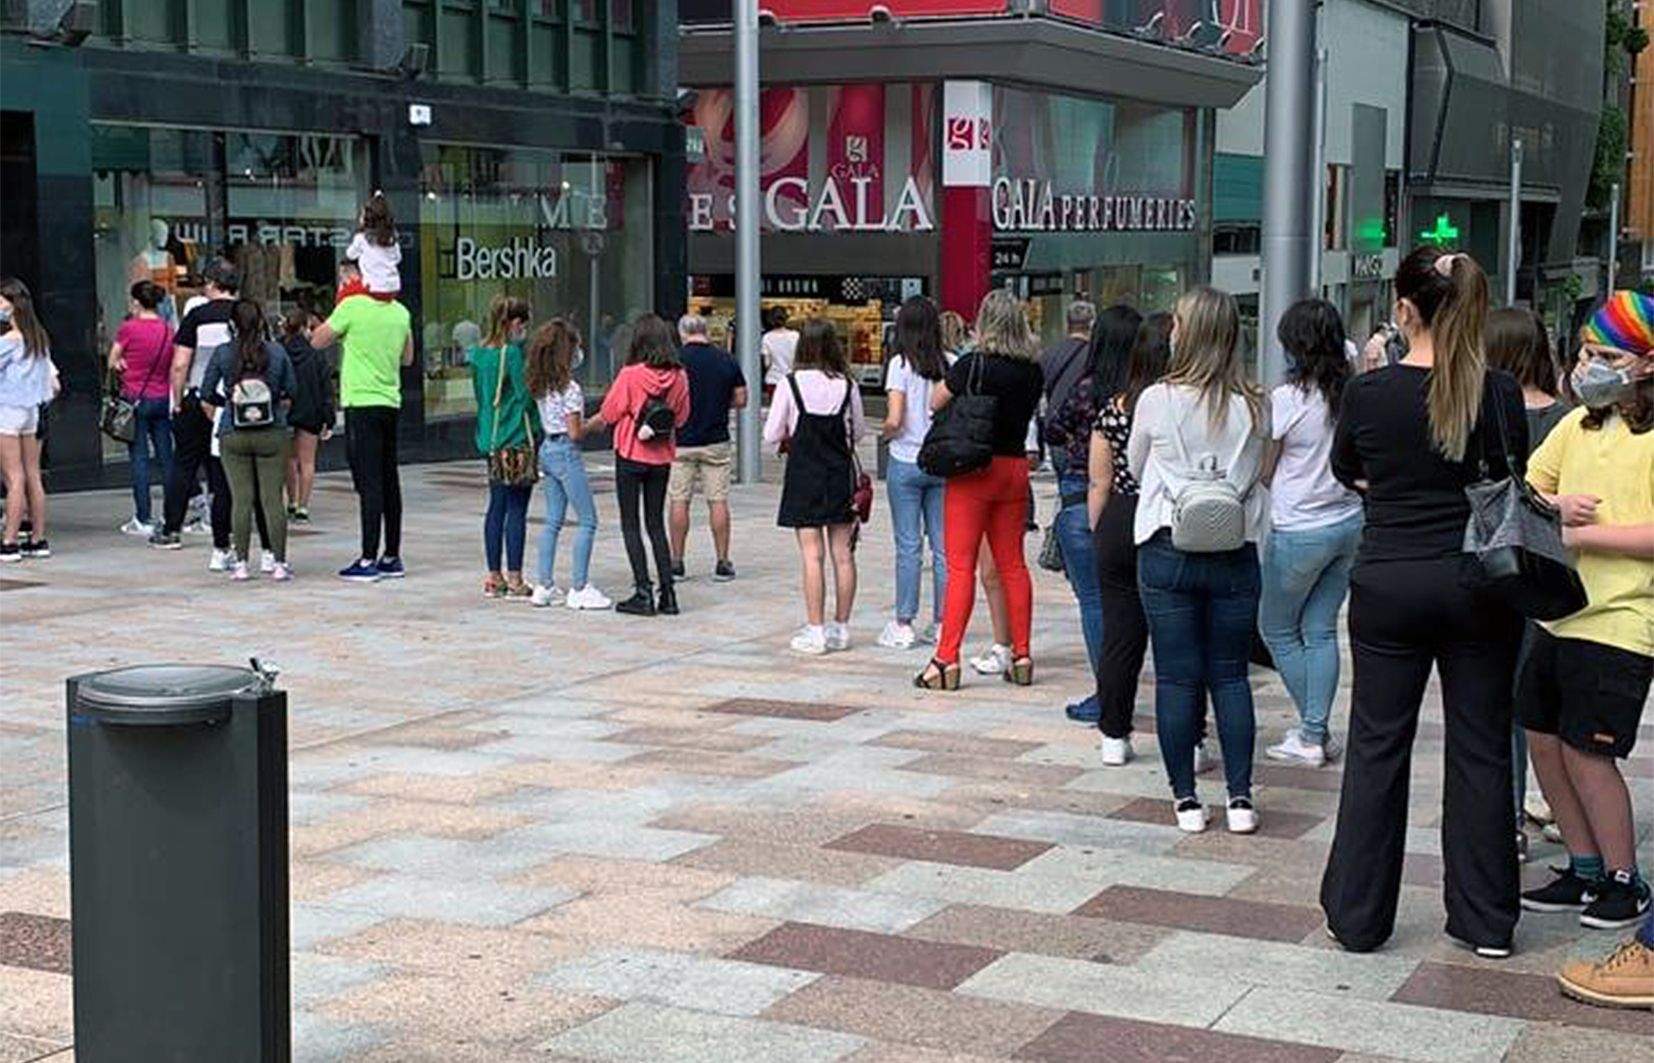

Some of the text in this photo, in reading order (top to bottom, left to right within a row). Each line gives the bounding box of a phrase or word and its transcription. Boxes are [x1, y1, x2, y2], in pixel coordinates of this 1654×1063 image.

[765, 176, 934, 231] GALA
[992, 176, 1196, 231] GALA PERFUMERIES
[456, 236, 557, 281] Bershka
